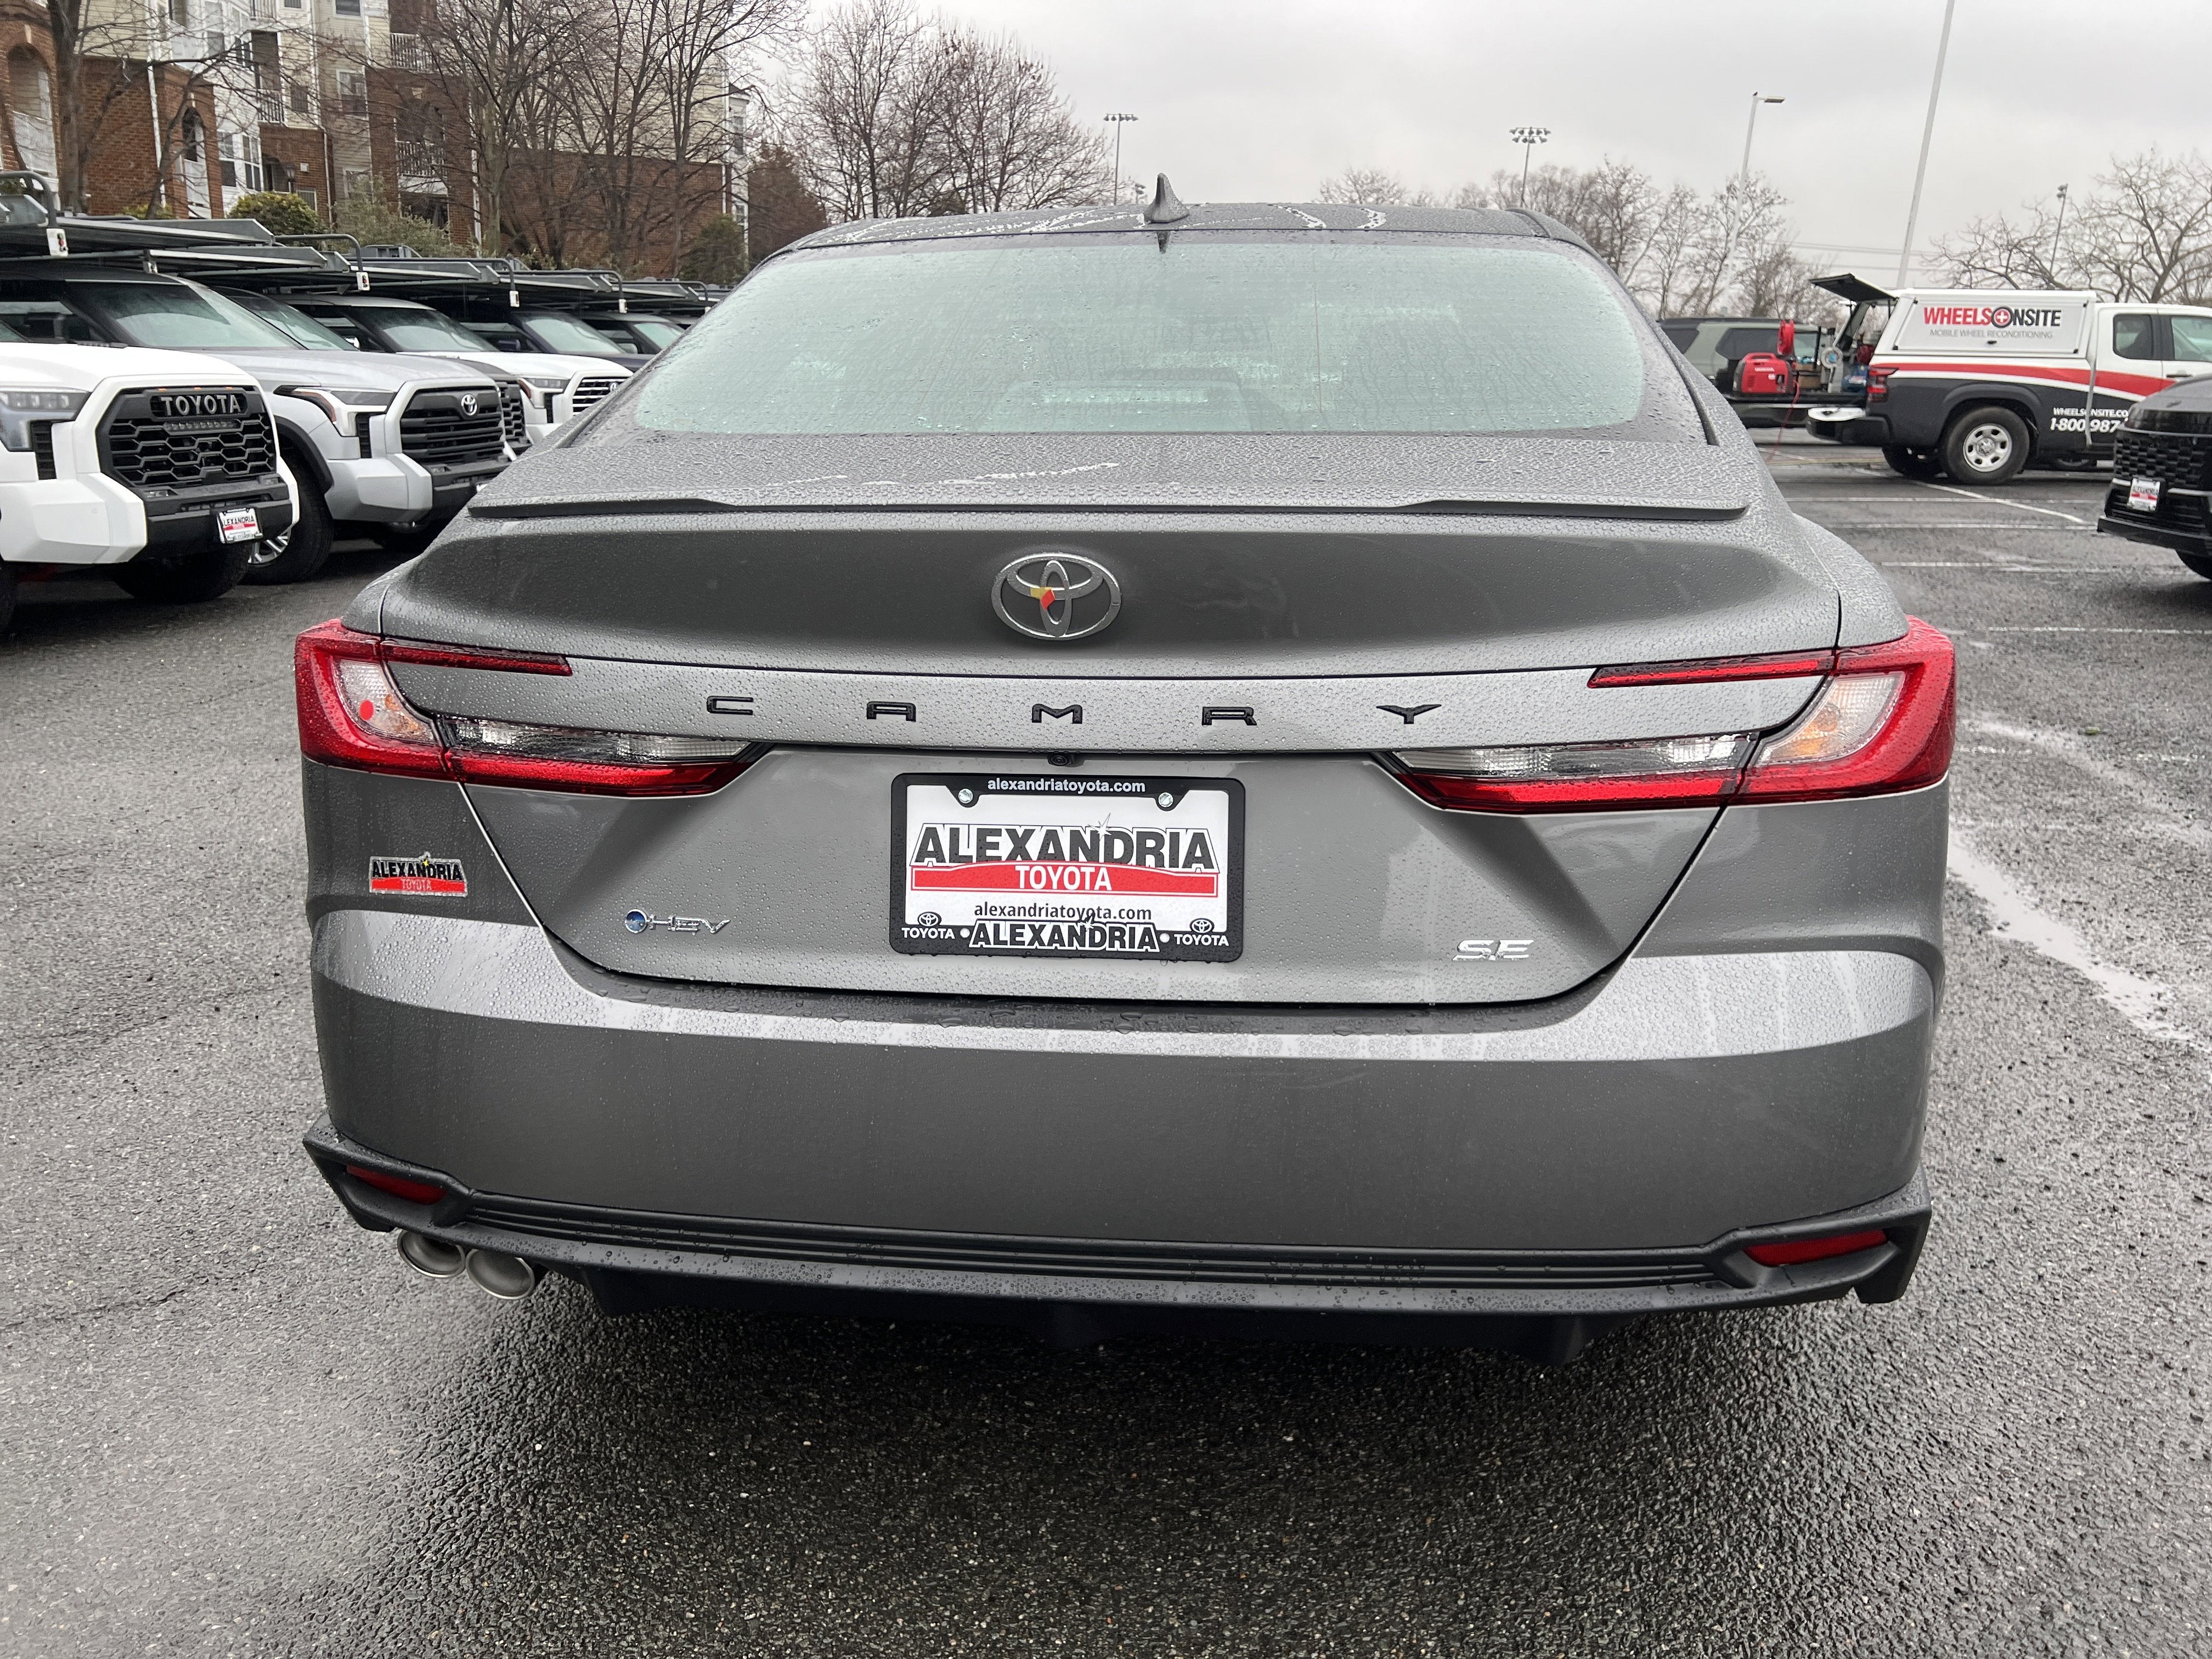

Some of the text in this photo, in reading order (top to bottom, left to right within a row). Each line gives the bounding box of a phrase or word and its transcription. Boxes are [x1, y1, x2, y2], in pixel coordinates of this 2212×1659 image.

[1930, 329, 2053, 338] MOBILE WHEEL RECONDITIONING
[161, 394, 241, 416] TOYOTA
[2053, 408, 2129, 417] WHEELSNSITE.CO
[706, 696, 1442, 726] CAMRY
[988, 777, 1146, 794] alexandriatoyota.com
[913, 825, 1216, 871] ALEXANDRIA
[372, 860, 464, 881] ALEXANDRIA
[1015, 865, 1113, 891] TOYOTA
[401, 878, 432, 891] TOYOTA
[974, 901, 1152, 922] alexandriatoyota.com
[901, 927, 955, 939] TOYOTA
[970, 919, 1159, 952] ALEXANDRIA
[1173, 934, 1229, 946] TOYOTA
[1452, 939, 1534, 961] SE
